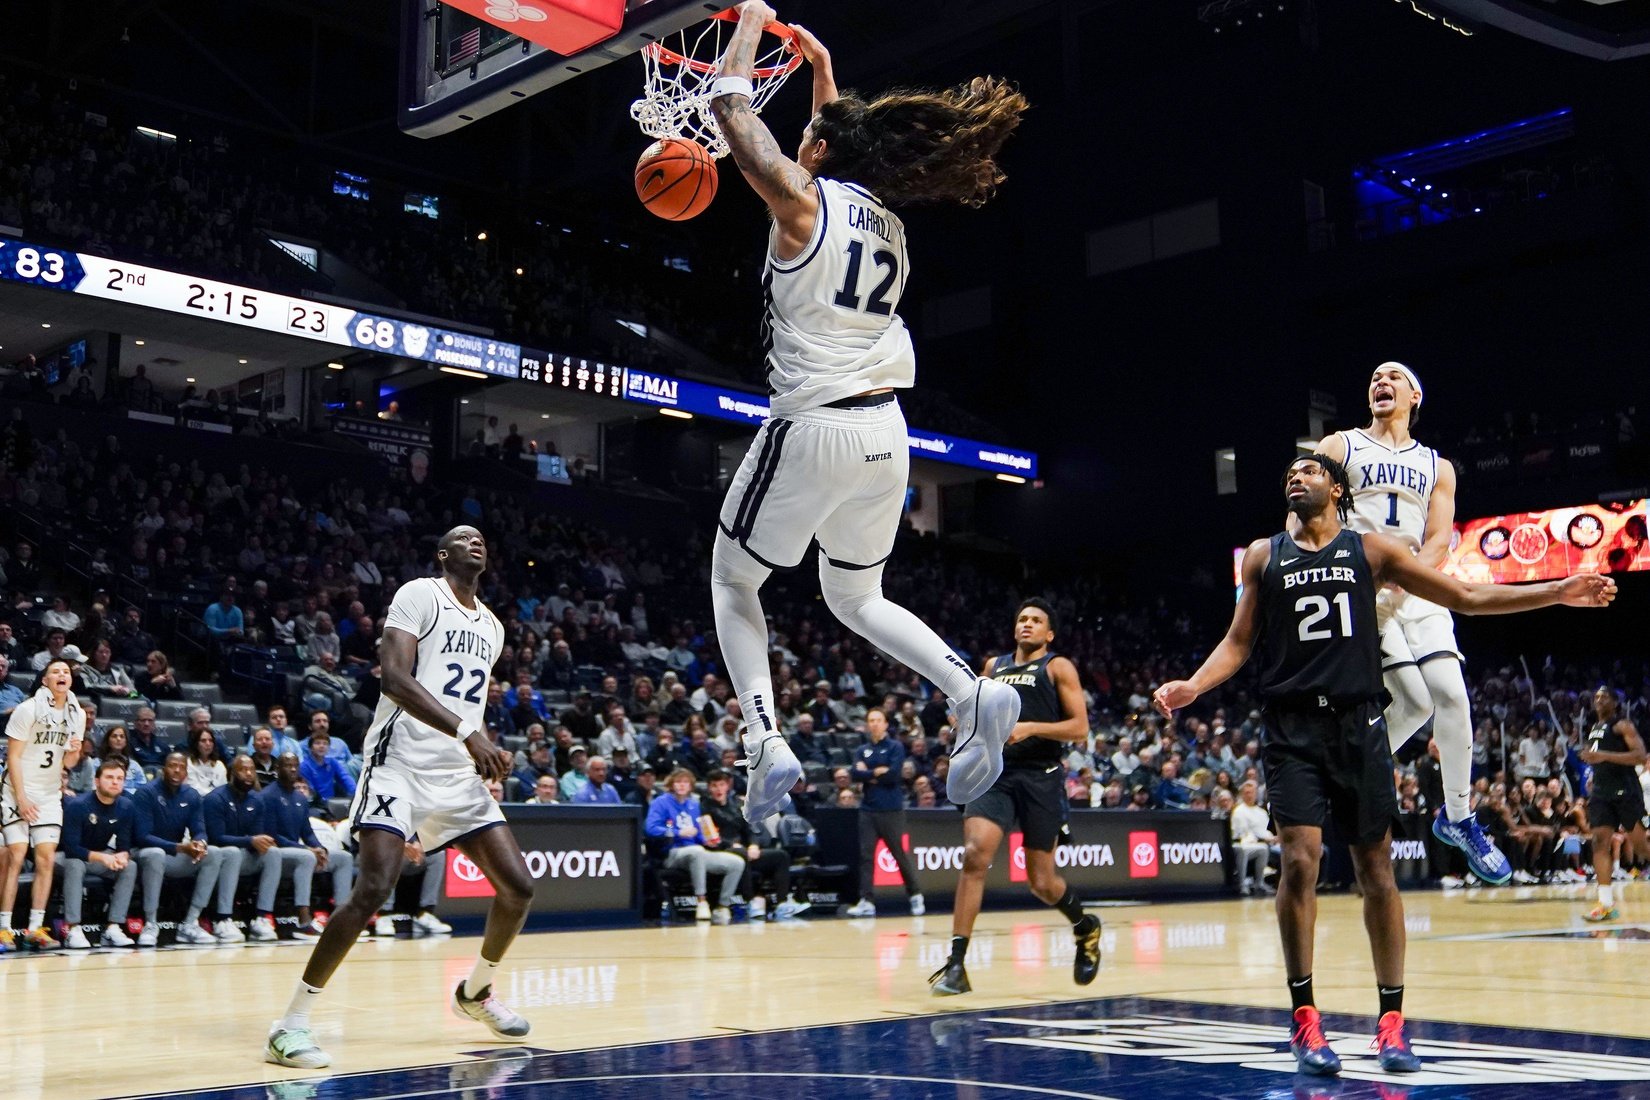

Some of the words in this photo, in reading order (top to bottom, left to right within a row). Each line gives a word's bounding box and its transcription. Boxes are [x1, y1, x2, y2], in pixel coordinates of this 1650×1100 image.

[848, 203, 891, 243] CARROLL
[15, 247, 65, 283] 83
[106, 268, 146, 292] 2nd
[832, 238, 898, 317] 12
[185, 283, 258, 320] 2:15
[290, 306, 326, 334] 23
[355, 317, 395, 350] 68
[454, 336, 483, 352] BONUS
[435, 348, 482, 369] POSSESSION
[487, 343, 496, 356] 2
[498, 345, 518, 360] TOL
[486, 359, 495, 371] 4
[497, 361, 517, 375] FLS
[522, 357, 540, 371] PTS
[522, 368, 539, 381] FLS
[643, 375, 678, 399] MAI
[718, 395, 735, 411] We
[864, 451, 892, 462] XAVIER
[1360, 462, 1427, 498] XAVIER
[1385, 492, 1400, 527] 1
[1283, 566, 1356, 590] BUTLER
[1294, 592, 1352, 642] 21
[442, 663, 486, 704] 22
[1317, 695, 1328, 707] B
[33, 731, 69, 747] XAVIE
[40, 750, 54, 768] 3
[370, 794, 398, 818] X
[521, 850, 620, 879] OYOTA
[913, 846, 966, 871] TOYO
[1055, 844, 1115, 867] OYOTA
[1159, 842, 1223, 866] TOYOTA
